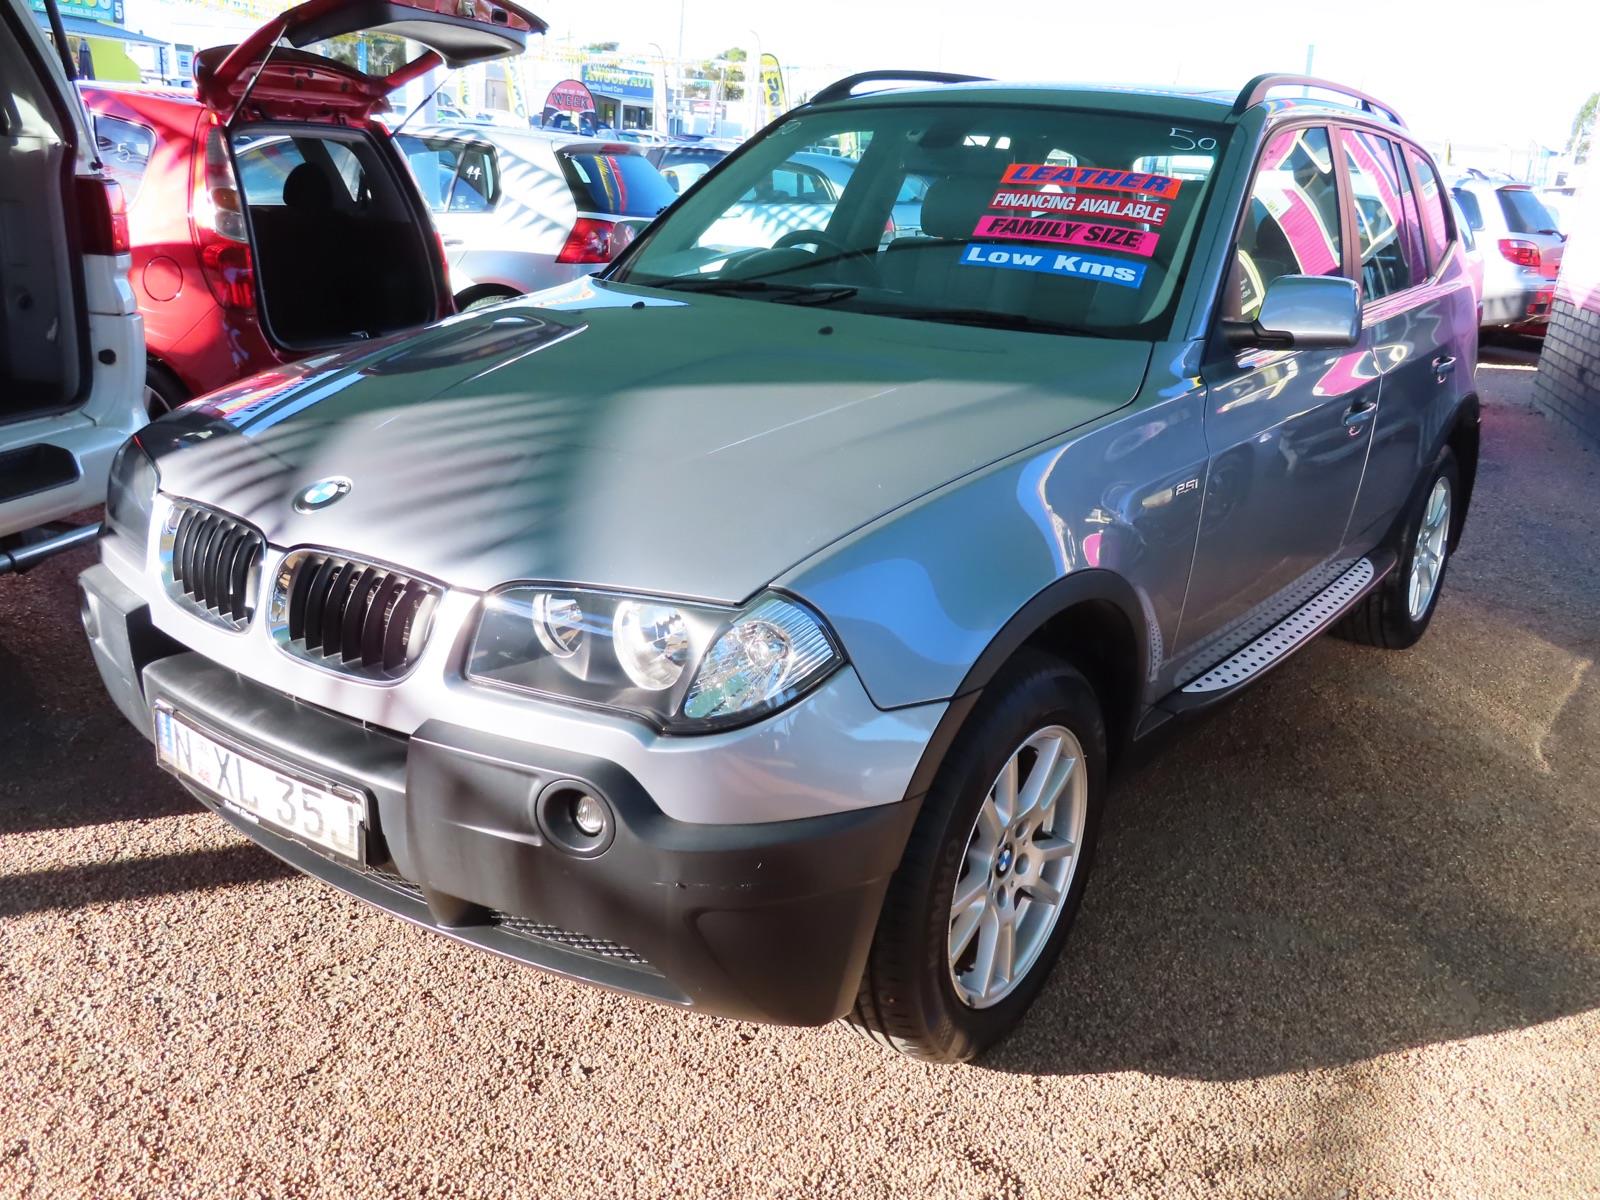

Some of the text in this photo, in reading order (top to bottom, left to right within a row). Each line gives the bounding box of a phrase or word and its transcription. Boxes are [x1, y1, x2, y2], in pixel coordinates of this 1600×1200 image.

[551, 92, 589, 110] WEEK
[1010, 166, 1173, 192] LEATHER
[991, 193, 1166, 223] FINANCING AVAILABLE
[987, 218, 1144, 248] FAMILY SIZE
[966, 247, 1137, 282] Low Kms
